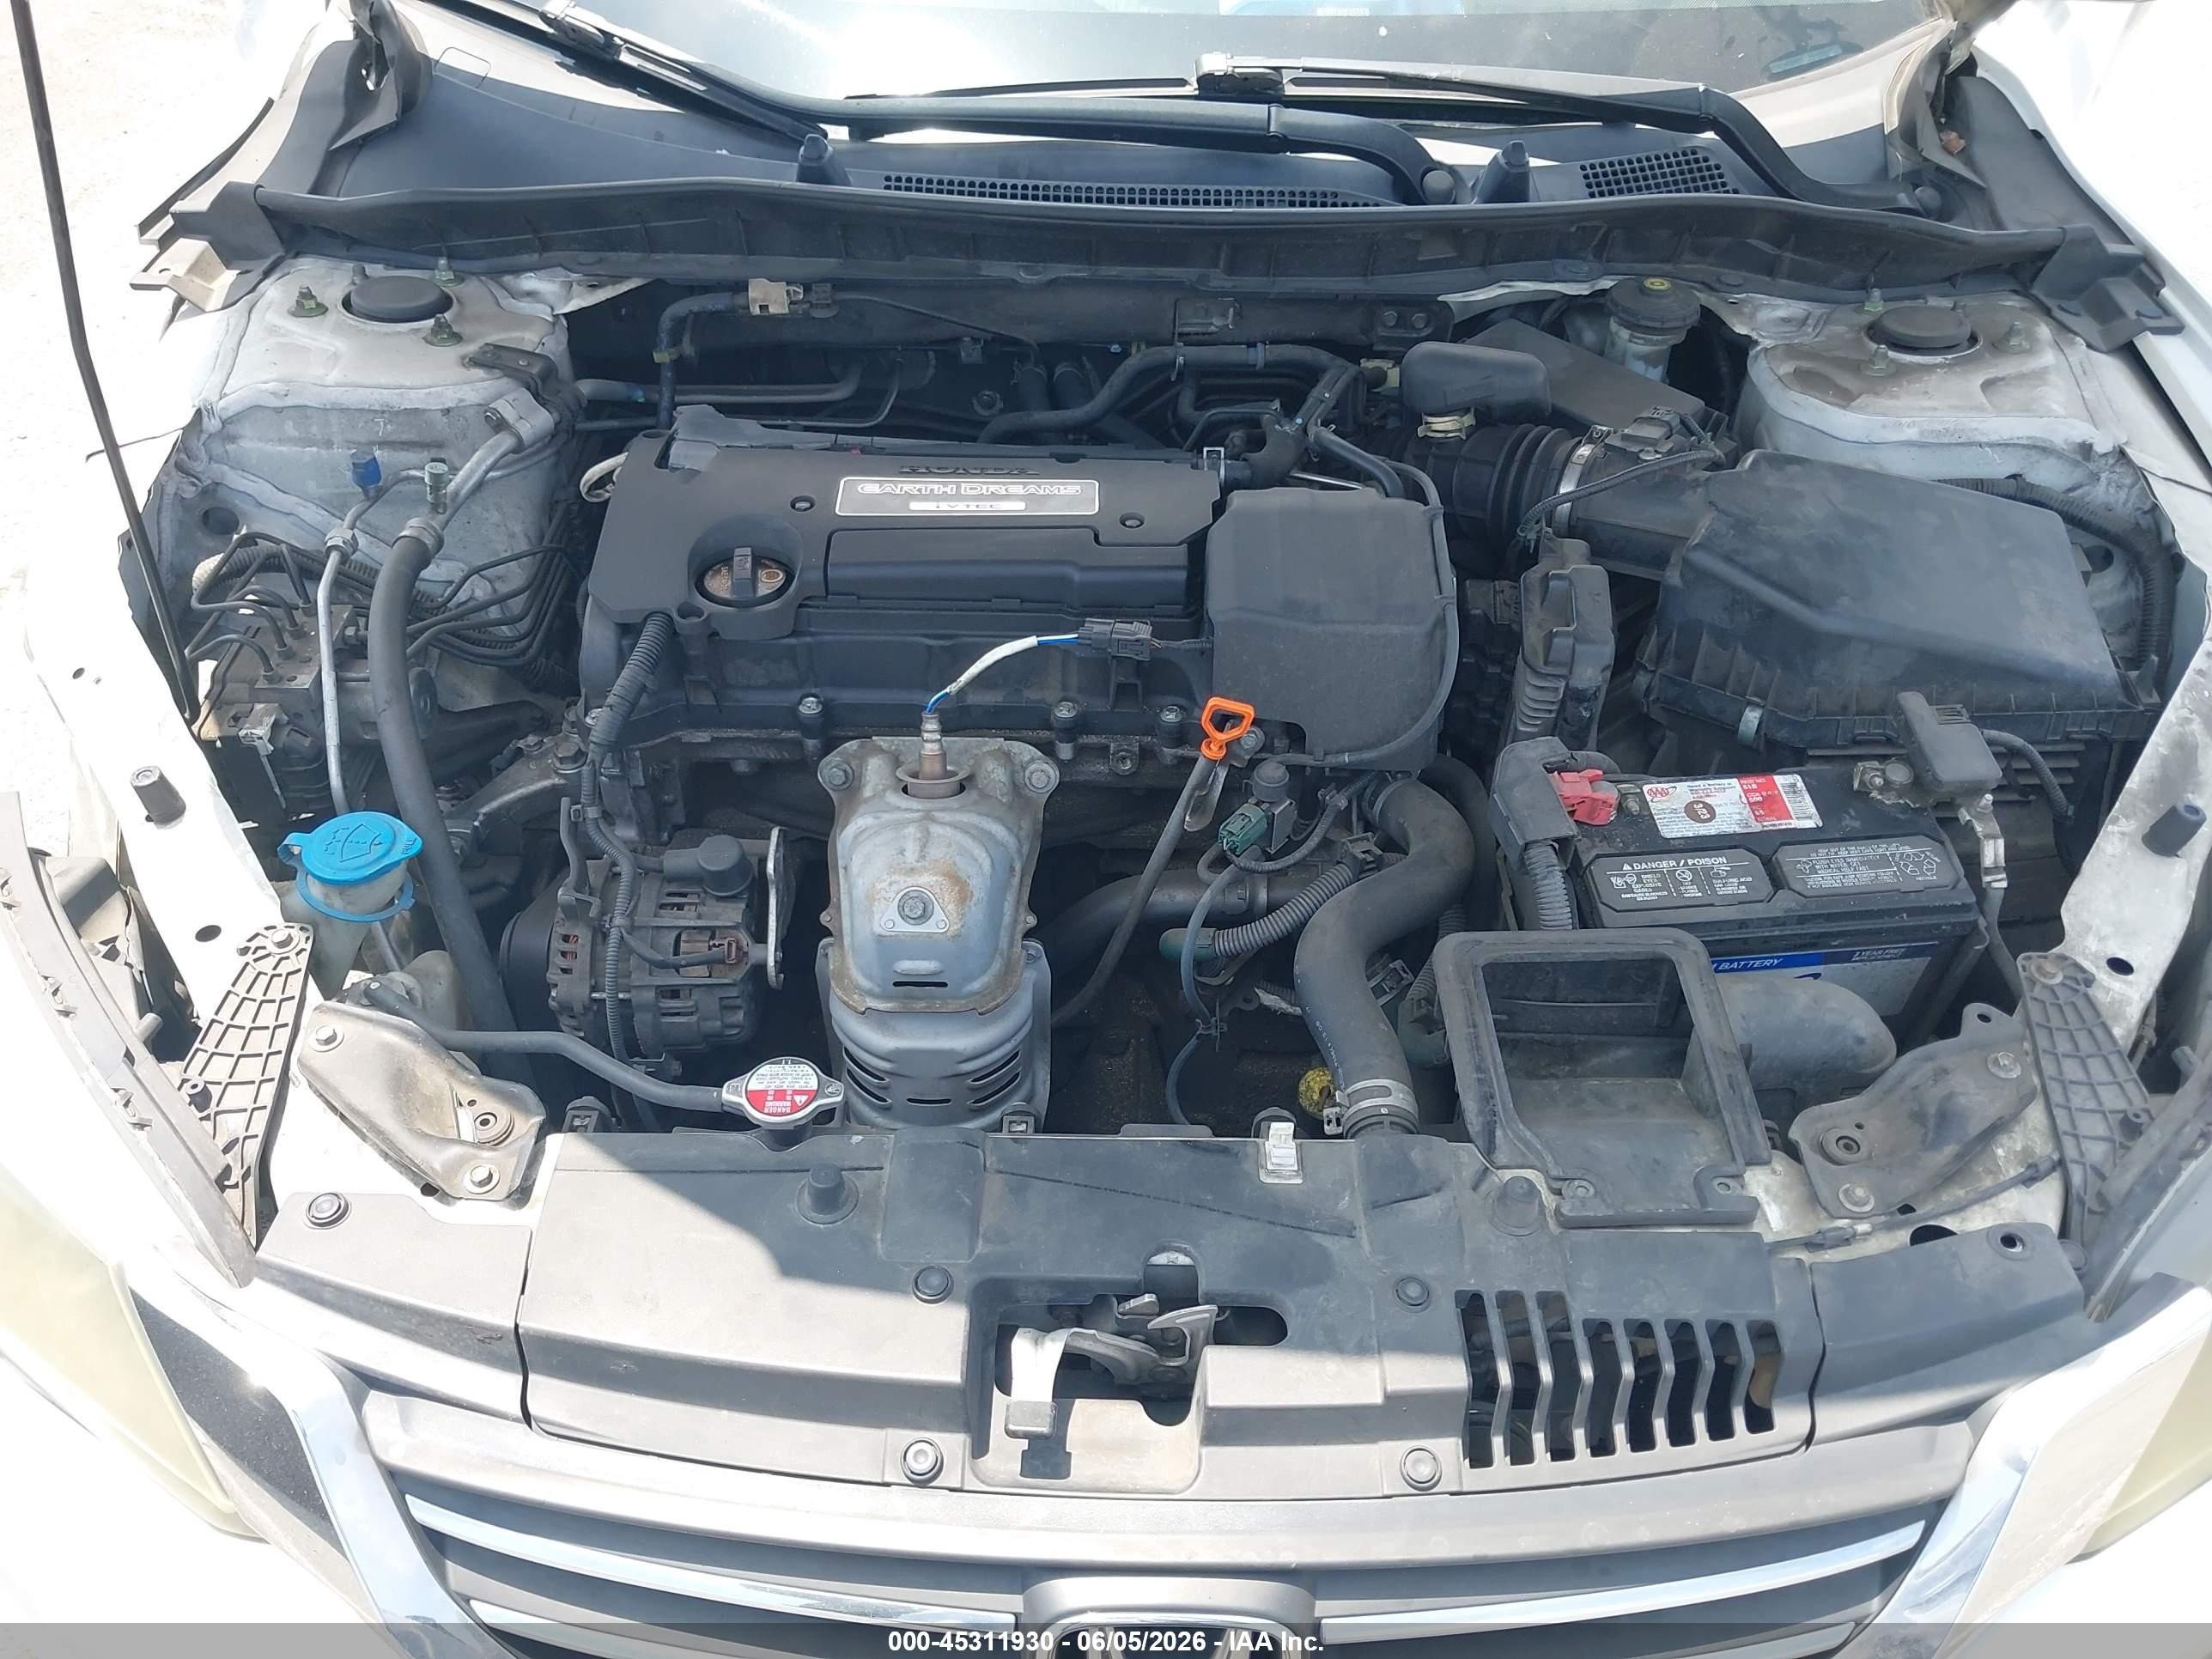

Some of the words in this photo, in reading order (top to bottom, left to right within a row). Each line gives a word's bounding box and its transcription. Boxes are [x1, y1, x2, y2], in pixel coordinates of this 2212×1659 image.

[899, 465, 1040, 476] HONDA
[858, 483, 957, 495] EARTH
[1647, 787, 1669, 798] AAA
[1693, 803, 1711, 820] 3/23
[401, 837, 417, 855] PULL
[1633, 860, 1677, 870] DANGER
[1687, 856, 1727, 866] POISON
[1717, 957, 1783, 970] BATTERY
